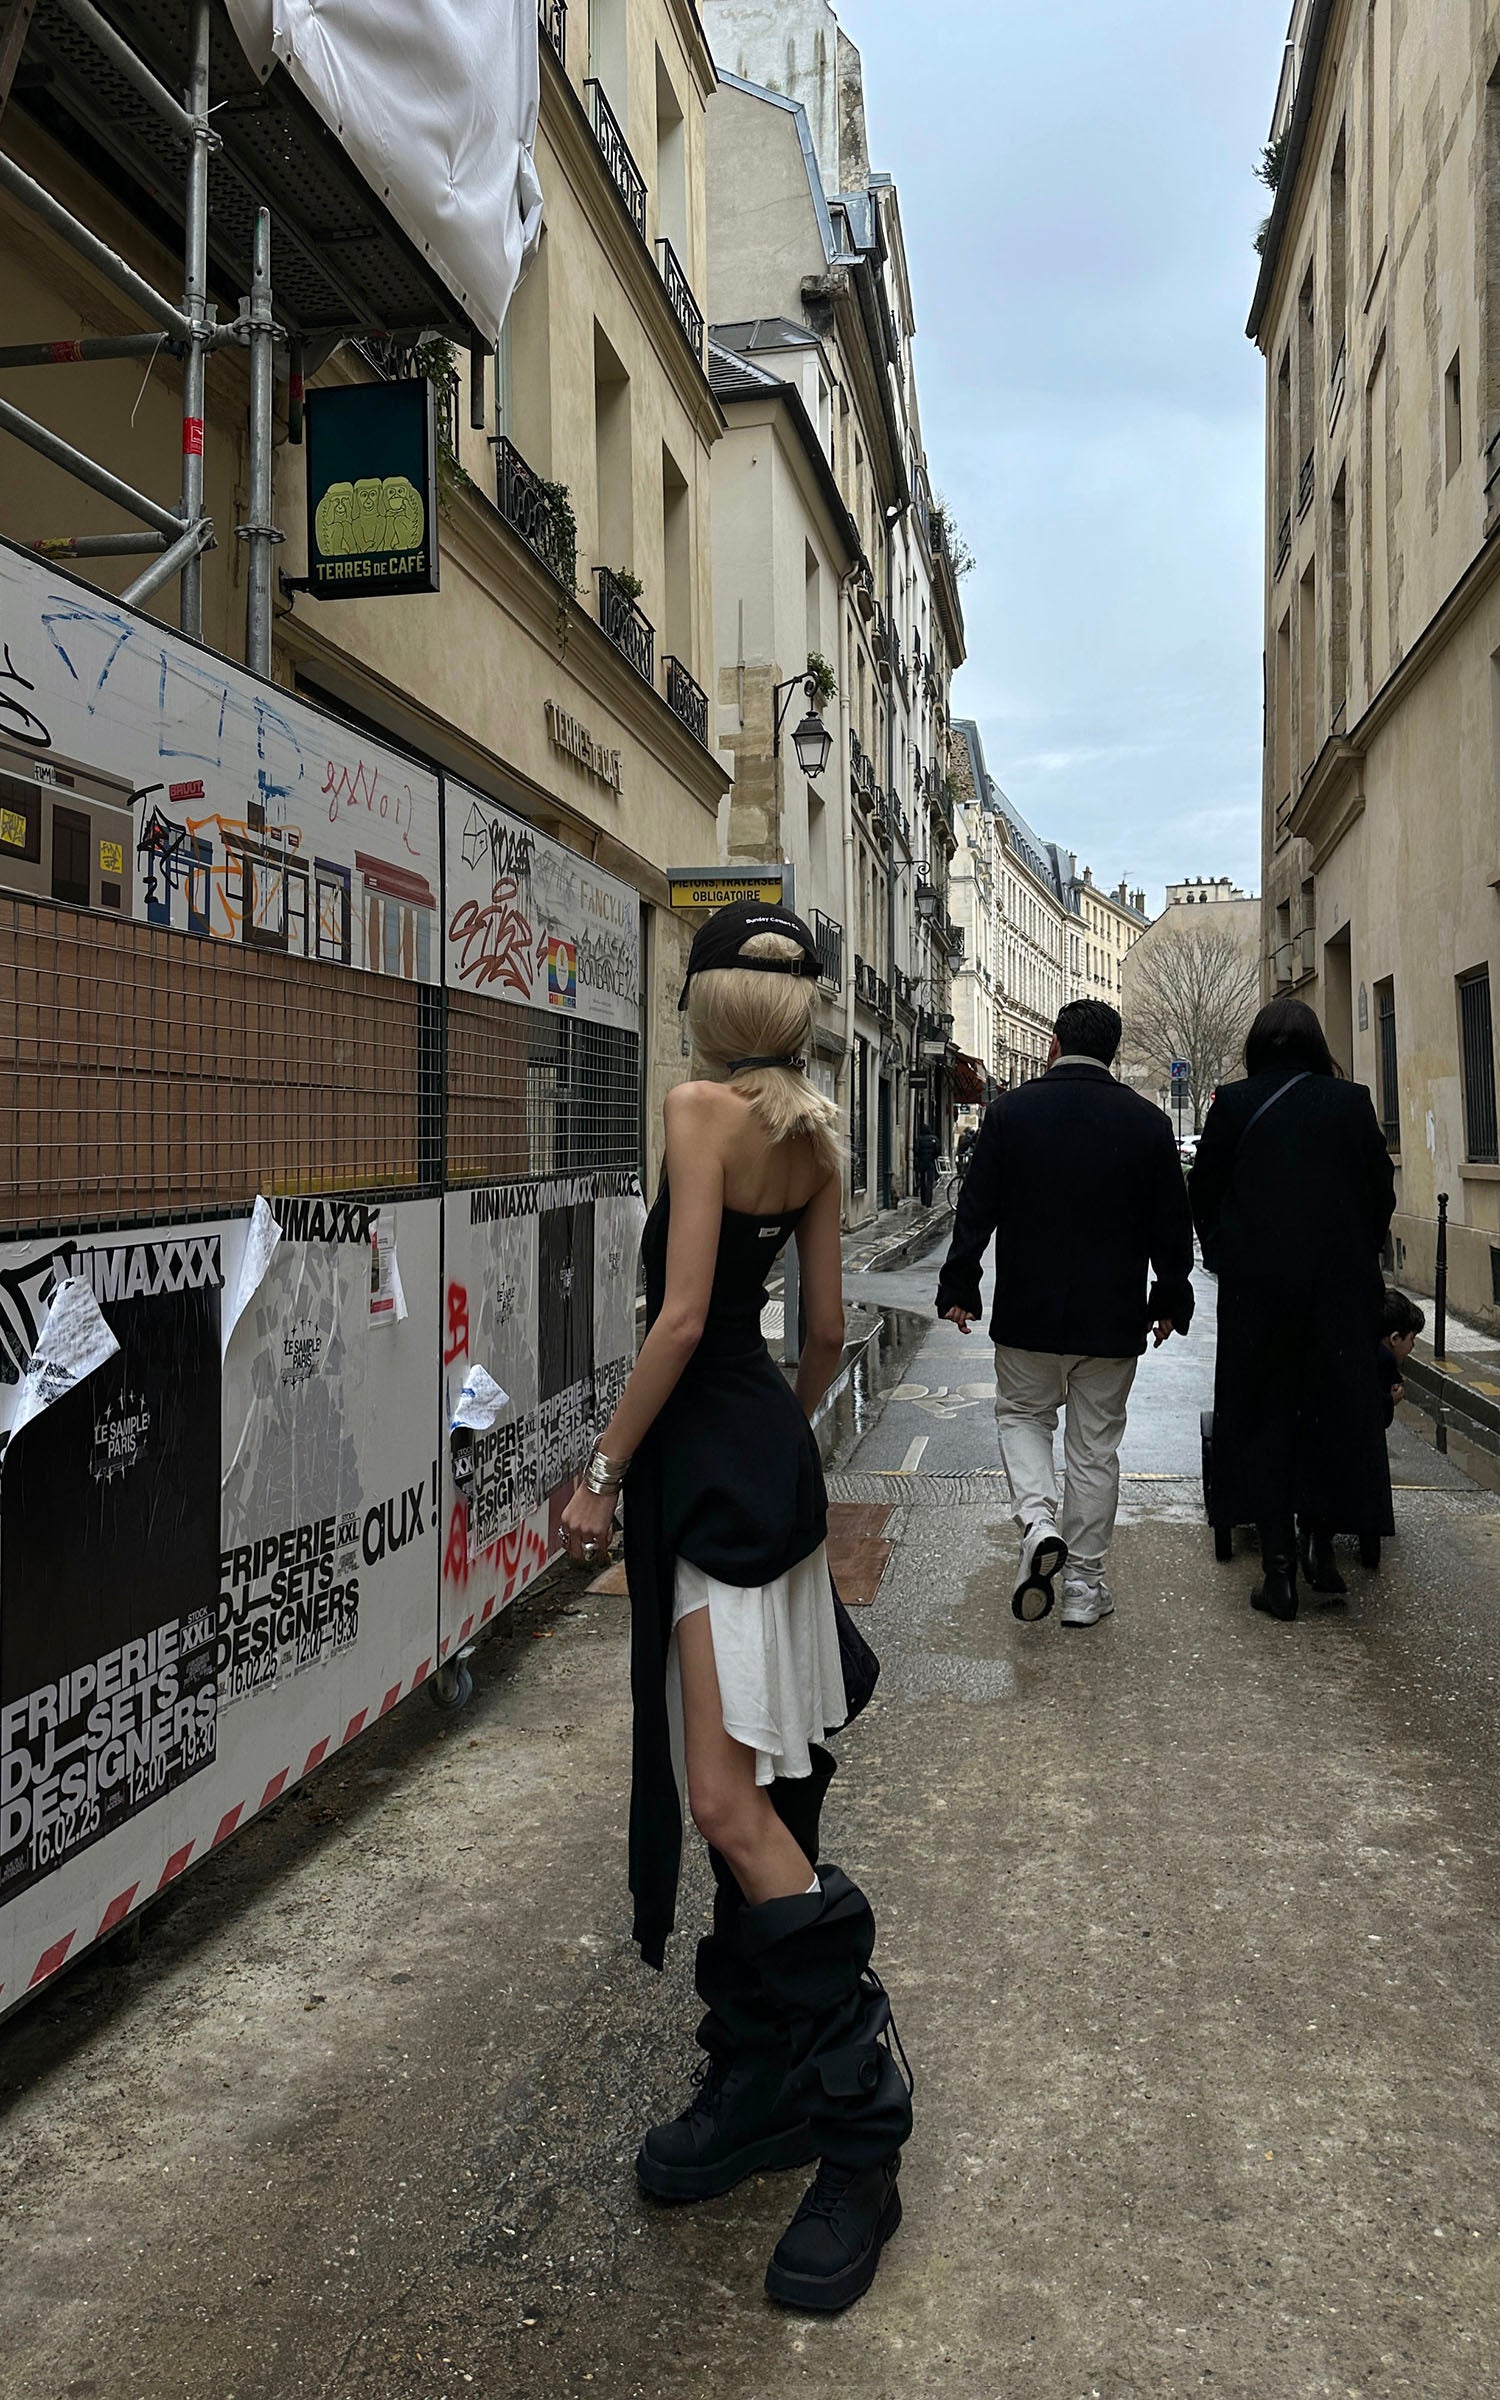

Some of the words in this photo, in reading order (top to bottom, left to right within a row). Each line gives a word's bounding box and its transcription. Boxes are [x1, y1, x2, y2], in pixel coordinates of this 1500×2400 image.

[316, 560, 371, 580] TERRES
[373, 562, 388, 576] DE
[389, 551, 425, 575] CAFÉ
[692, 890, 760, 902] OBLIGATOIRE
[108, 1434, 136, 1458] PARIS
[454, 1456, 473, 1477] XX
[338, 1522, 360, 1546] XXL
[362, 1480, 425, 1566] aux
[219, 1516, 336, 1587] FRIPERIE
[181, 1617, 214, 1654] XXL
[188, 1605, 208, 1624] STOCK
[216, 1578, 359, 1675] DESIGNERS
[1, 1618, 179, 1756] FRIPERIE
[229, 1646, 277, 1697] 16.02.25
[0, 1683, 217, 1856] DESIGNERS
[29, 1791, 100, 1871] 16.02.25
